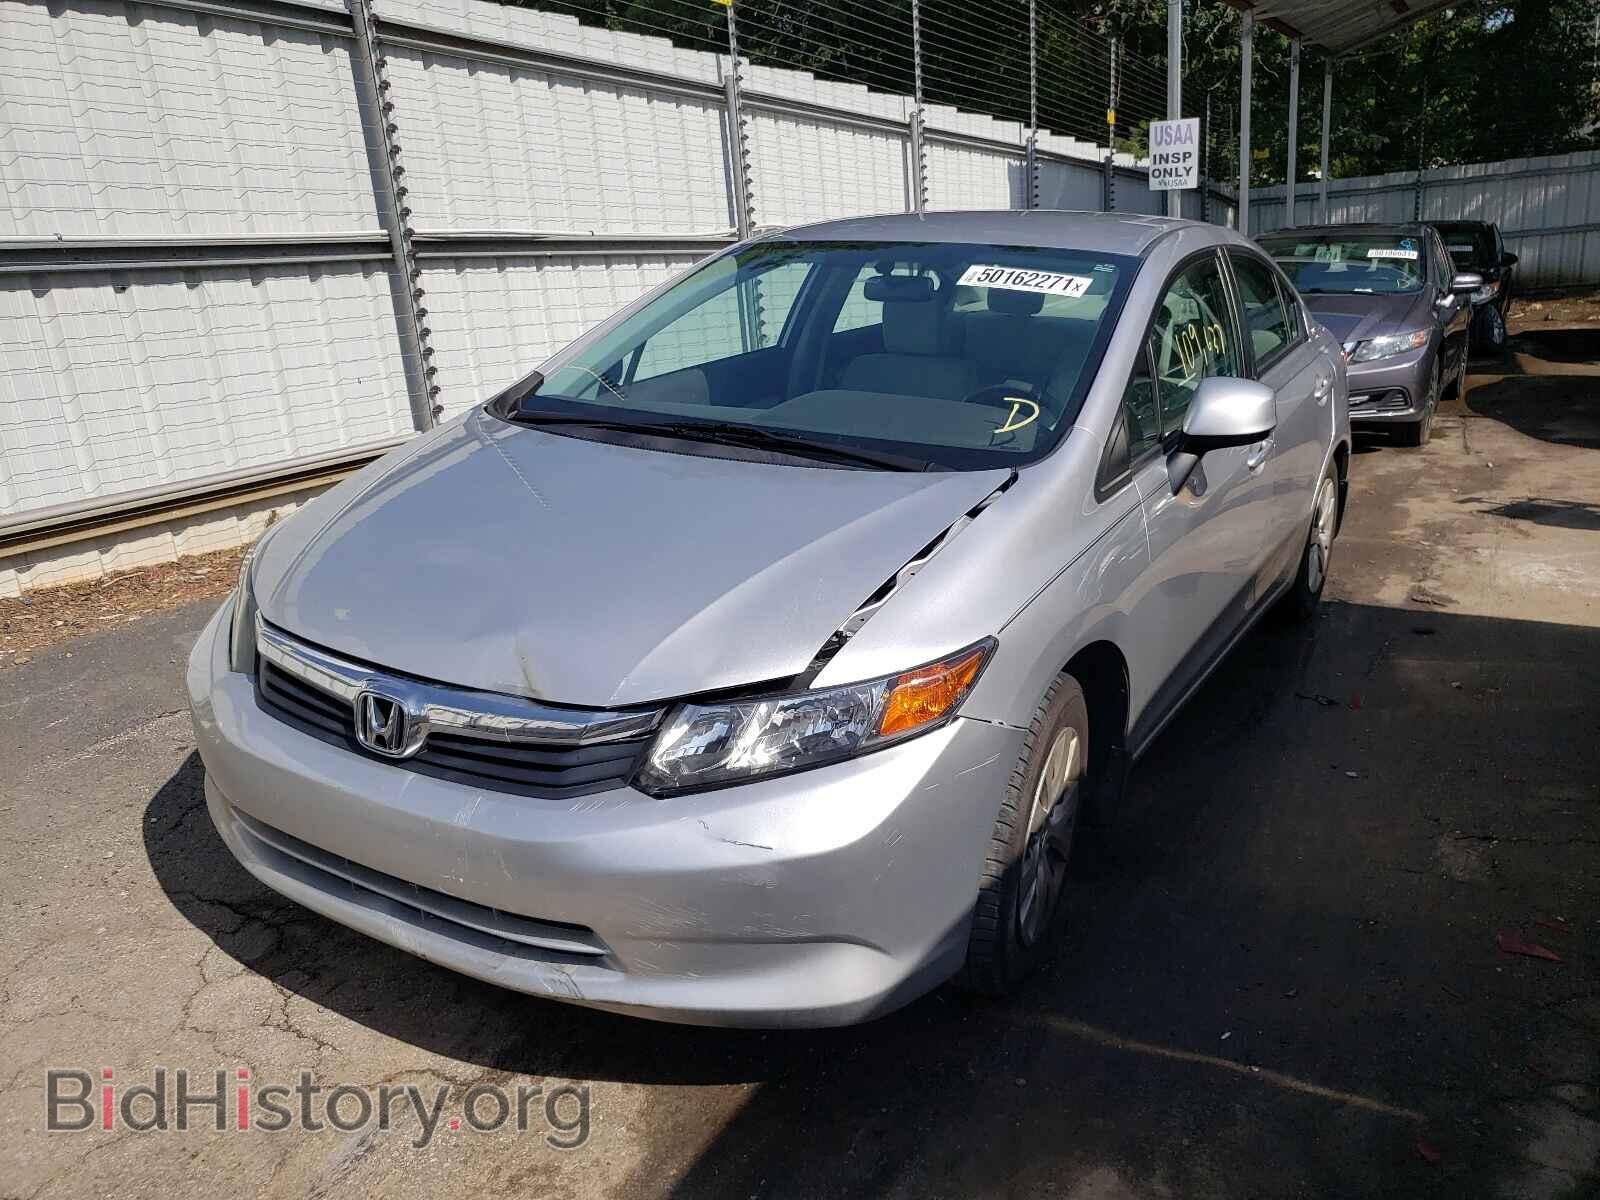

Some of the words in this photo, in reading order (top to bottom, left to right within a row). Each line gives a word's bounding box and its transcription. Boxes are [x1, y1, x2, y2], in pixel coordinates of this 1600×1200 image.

[1153, 123, 1194, 146] USAA
[1152, 151, 1192, 166] INSP
[1151, 166, 1193, 179] ONLY
[993, 397, 1040, 434] D
